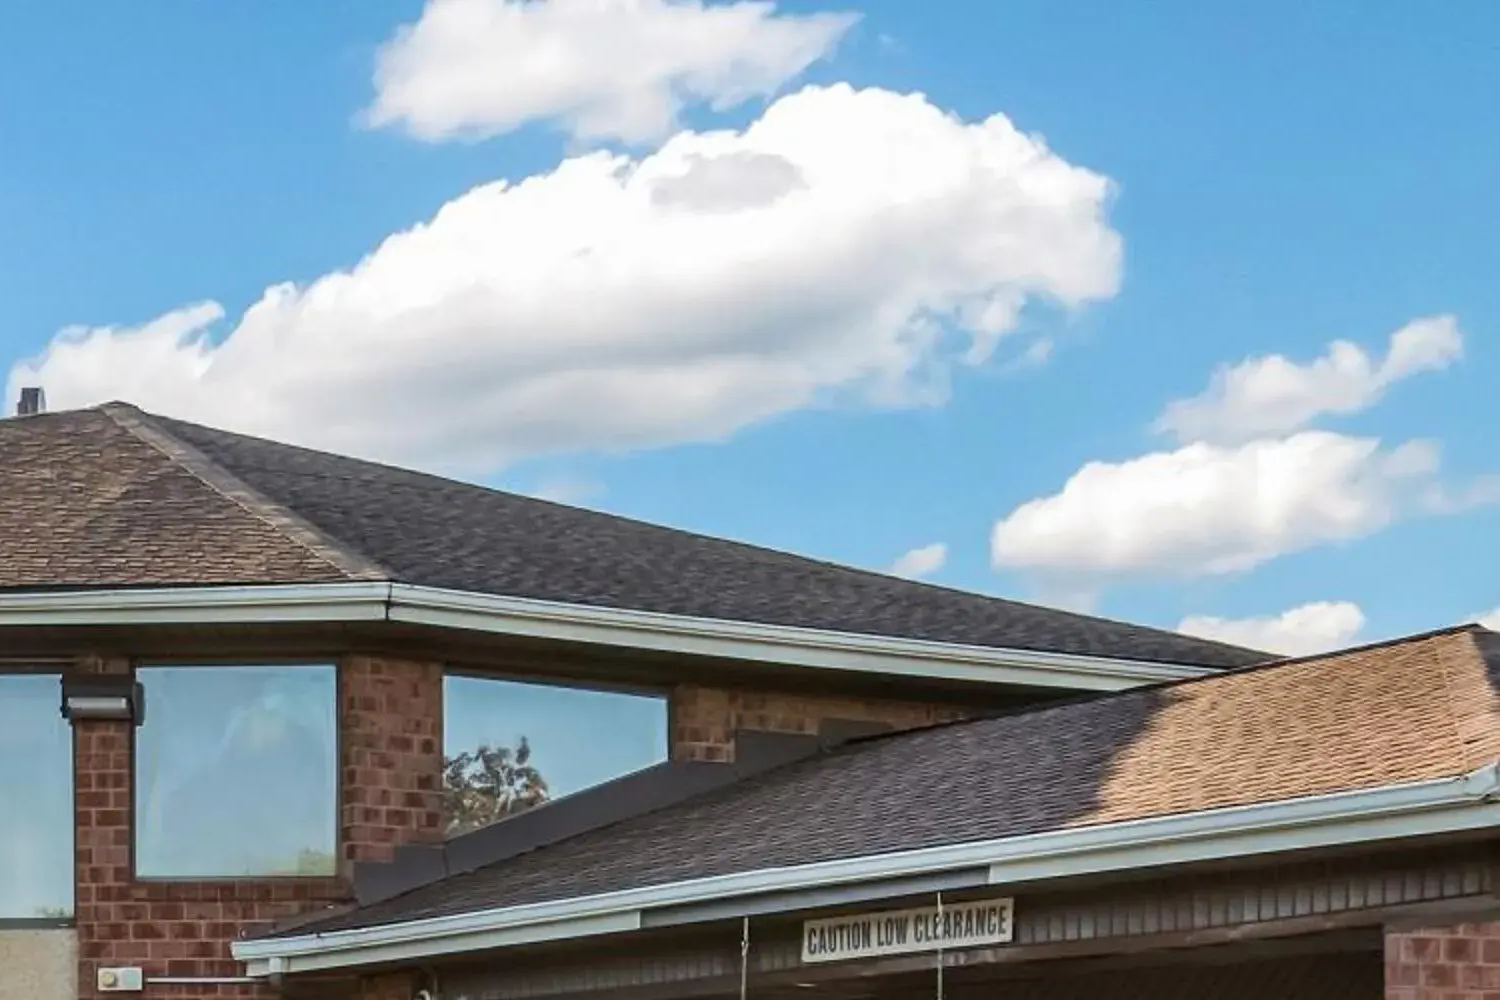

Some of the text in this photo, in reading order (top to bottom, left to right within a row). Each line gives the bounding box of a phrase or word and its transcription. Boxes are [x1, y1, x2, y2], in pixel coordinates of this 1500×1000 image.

[807, 905, 1007, 955] CAUTION LOW CLEARANCE
